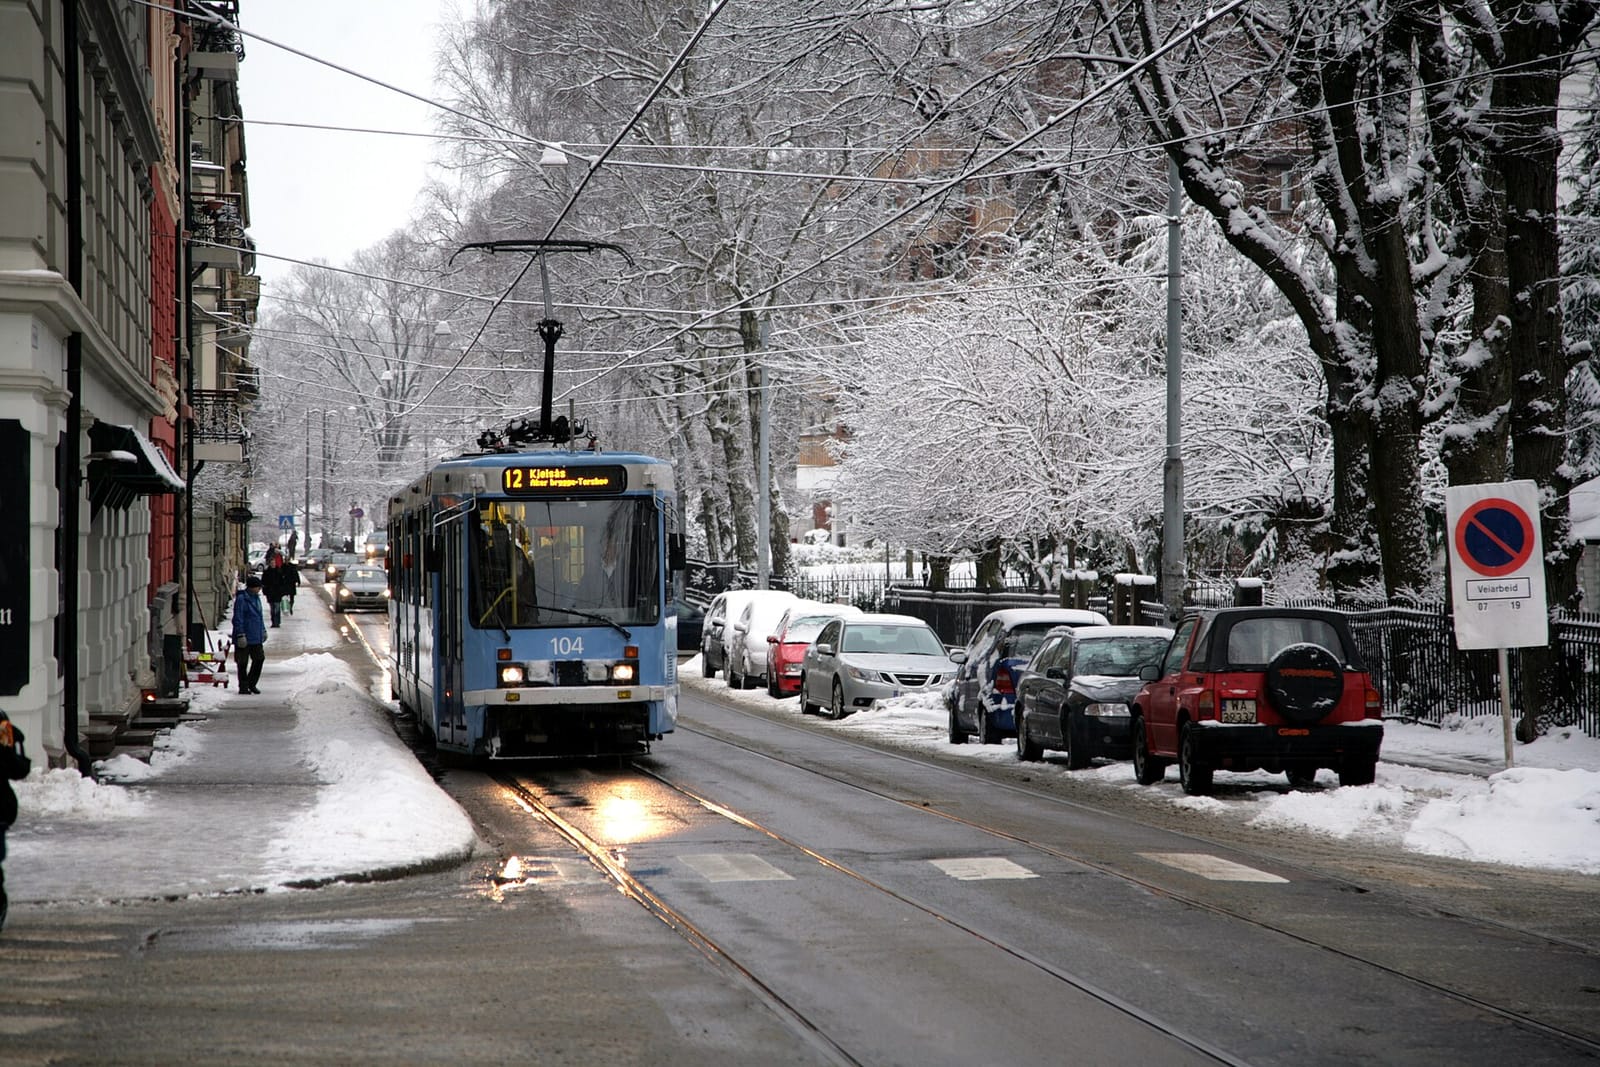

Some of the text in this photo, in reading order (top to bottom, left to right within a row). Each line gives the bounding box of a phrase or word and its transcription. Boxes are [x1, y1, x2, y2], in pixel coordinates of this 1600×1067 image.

[505, 469, 522, 488] 12
[1477, 584, 1518, 593] Veiarbeid
[1478, 601, 1521, 611] 07 19
[550, 636, 584, 655] 104
